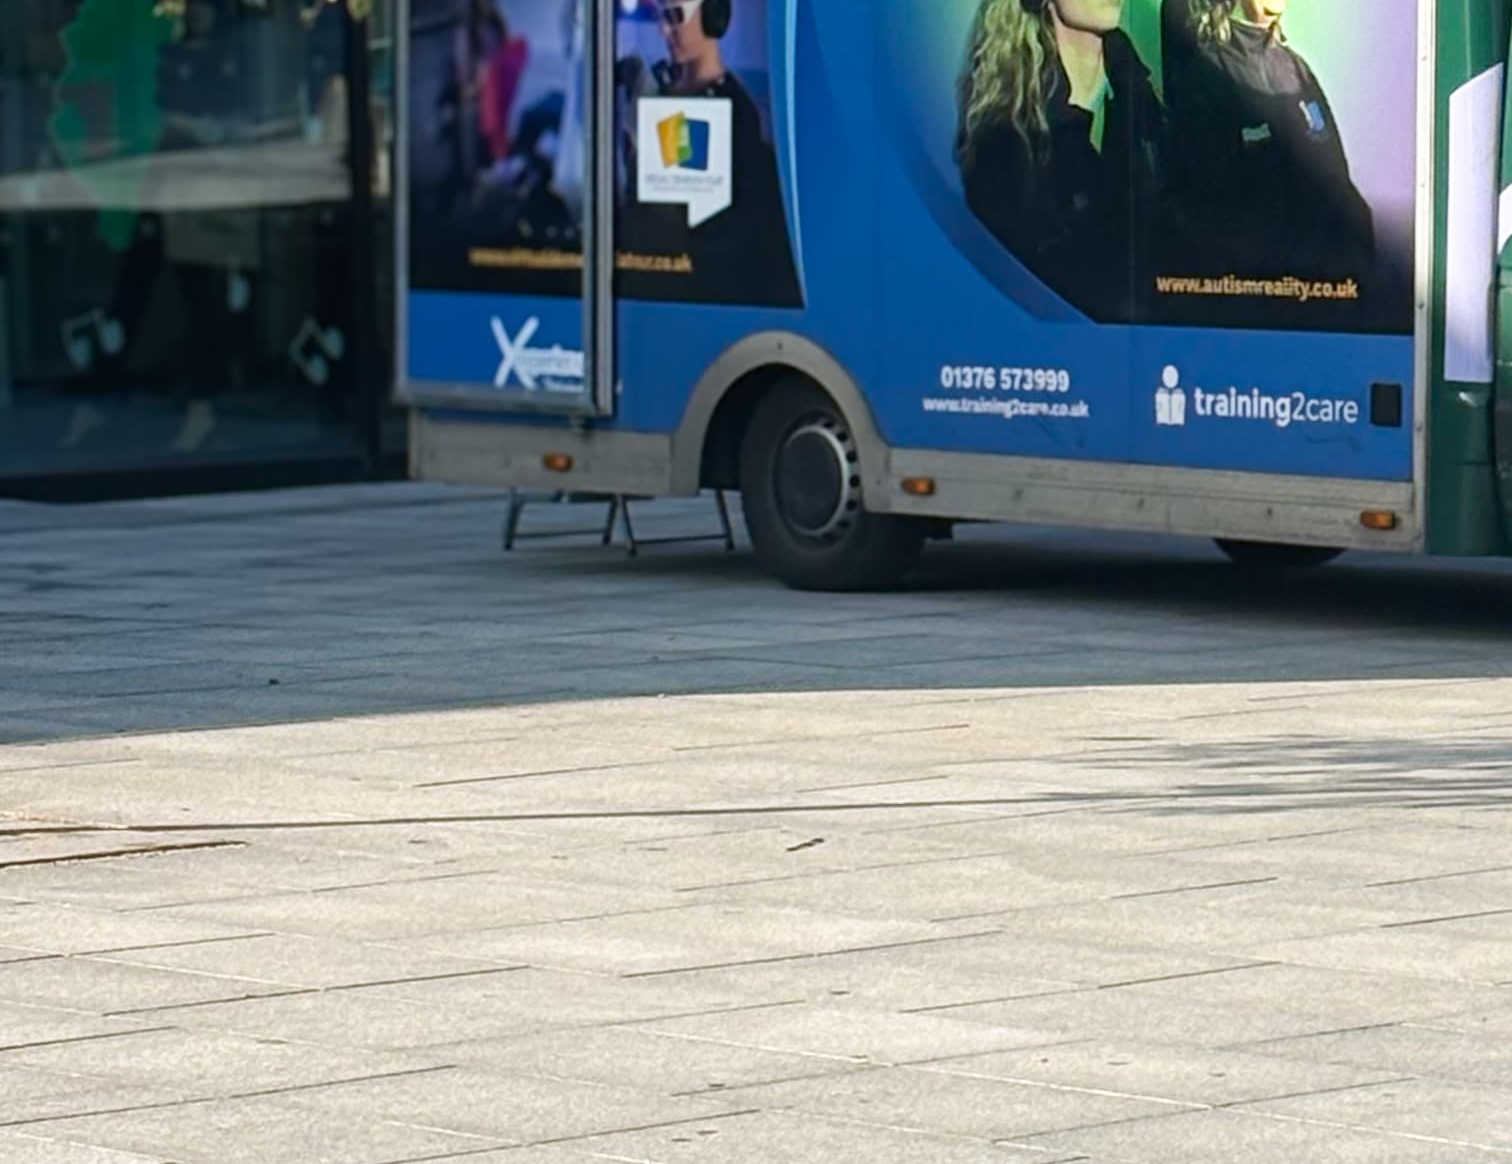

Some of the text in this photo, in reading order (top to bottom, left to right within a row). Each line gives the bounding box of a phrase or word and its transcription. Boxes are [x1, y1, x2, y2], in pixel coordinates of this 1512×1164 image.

[1156, 274, 1359, 302] www.autismreality.co.uk
[940, 365, 1070, 393] 01376 573999
[922, 396, 1090, 419] www.training2care.co.uk
[1194, 386, 1359, 428] training2care
